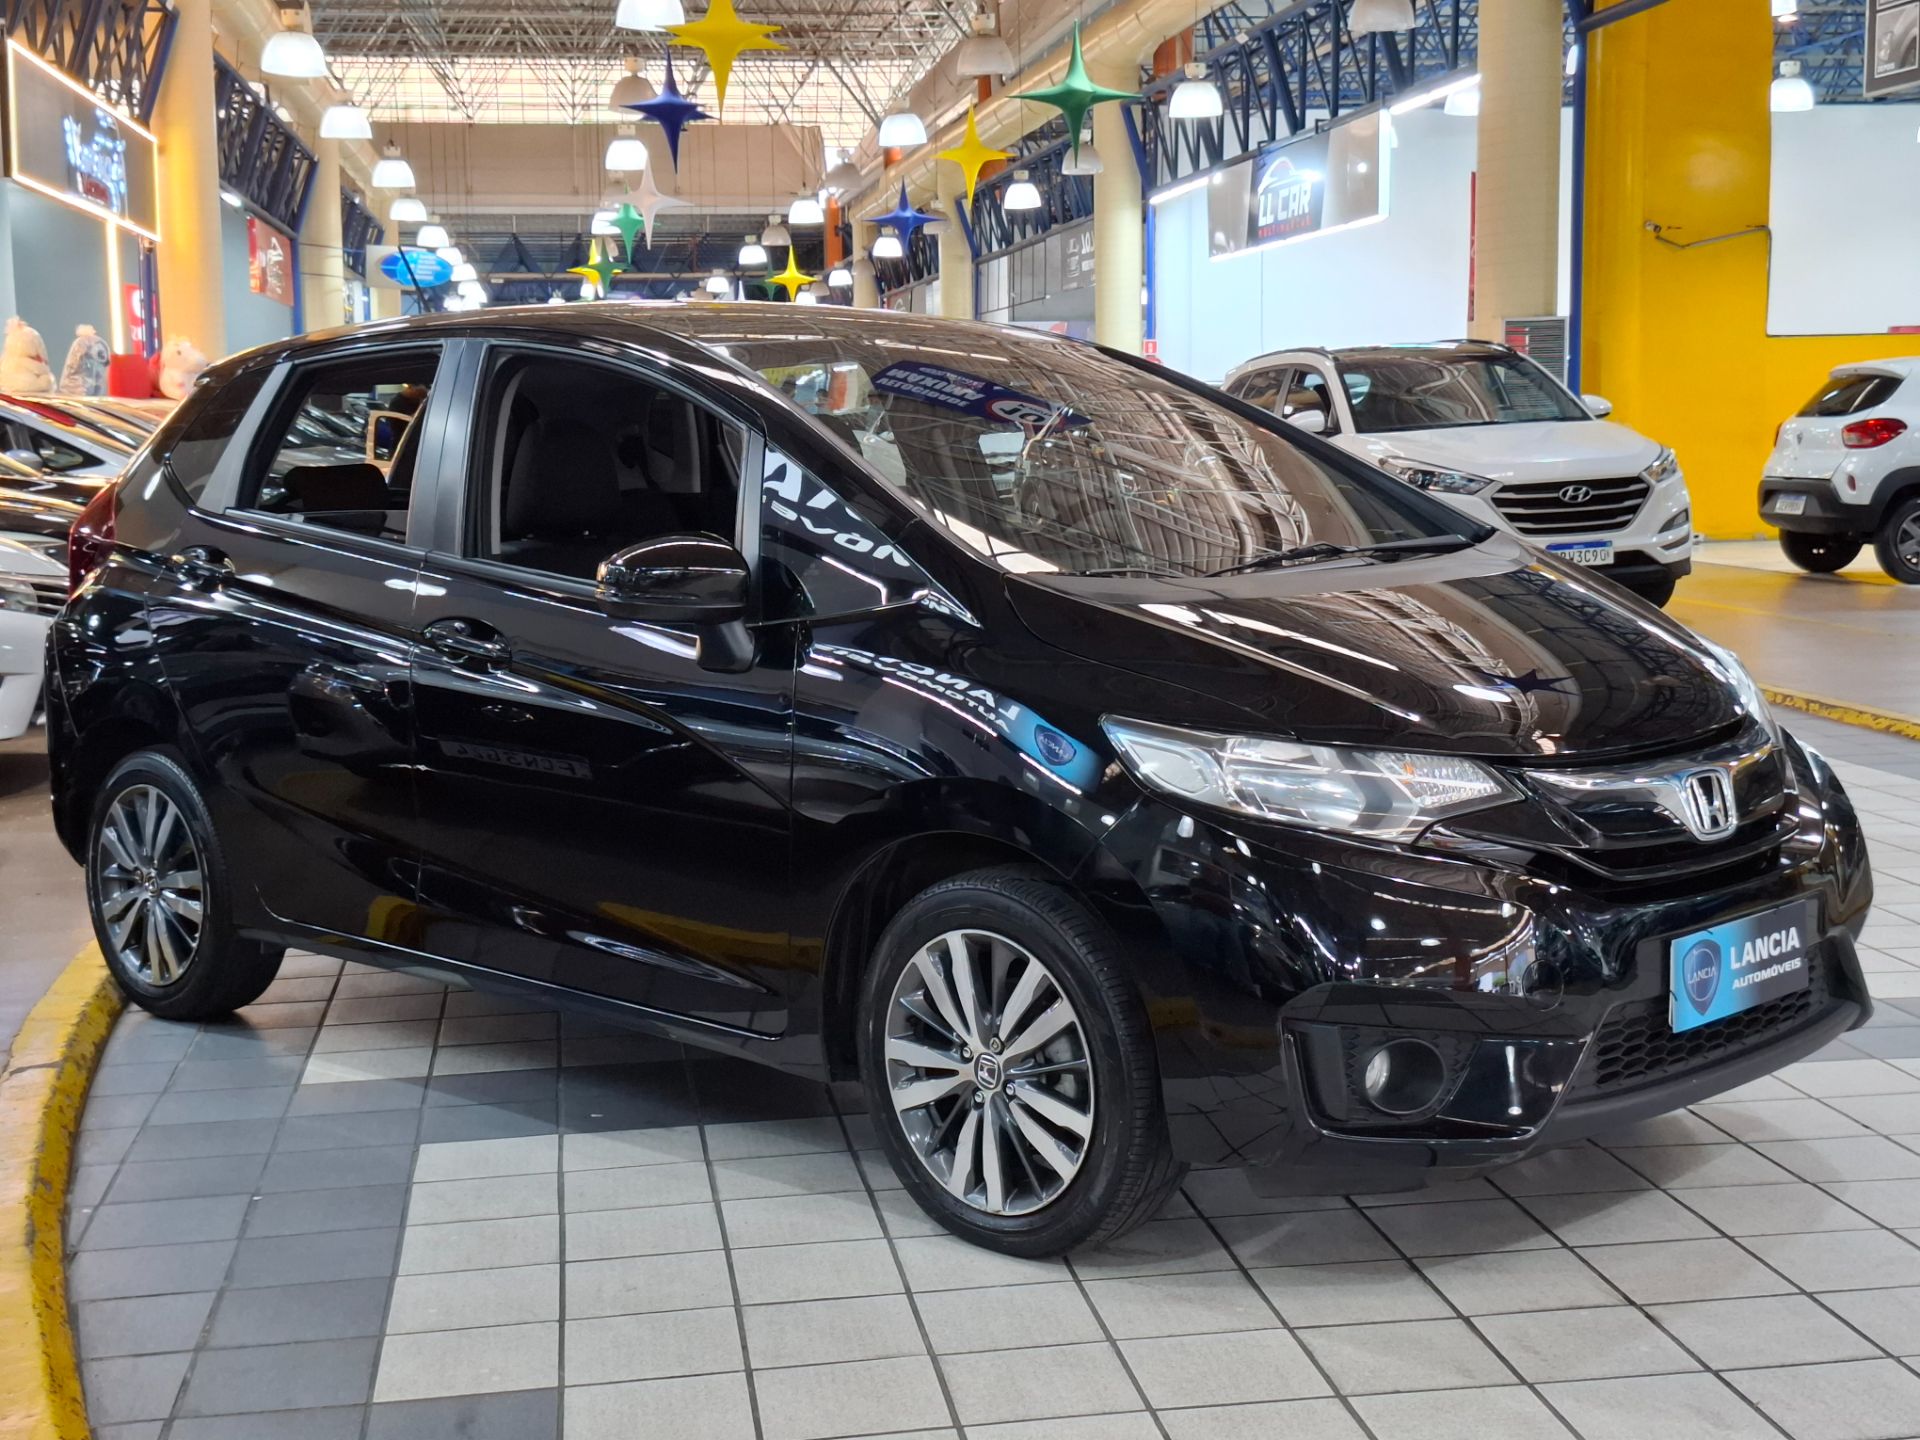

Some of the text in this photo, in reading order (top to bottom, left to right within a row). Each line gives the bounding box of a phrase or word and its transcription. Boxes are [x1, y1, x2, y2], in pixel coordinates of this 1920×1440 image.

[1277, 182, 1312, 221] CAR
[1730, 926, 1800, 970] LANCIA
[1687, 965, 1717, 984] LANCIA
[1731, 957, 1802, 990] AUTOMÓVEIS
